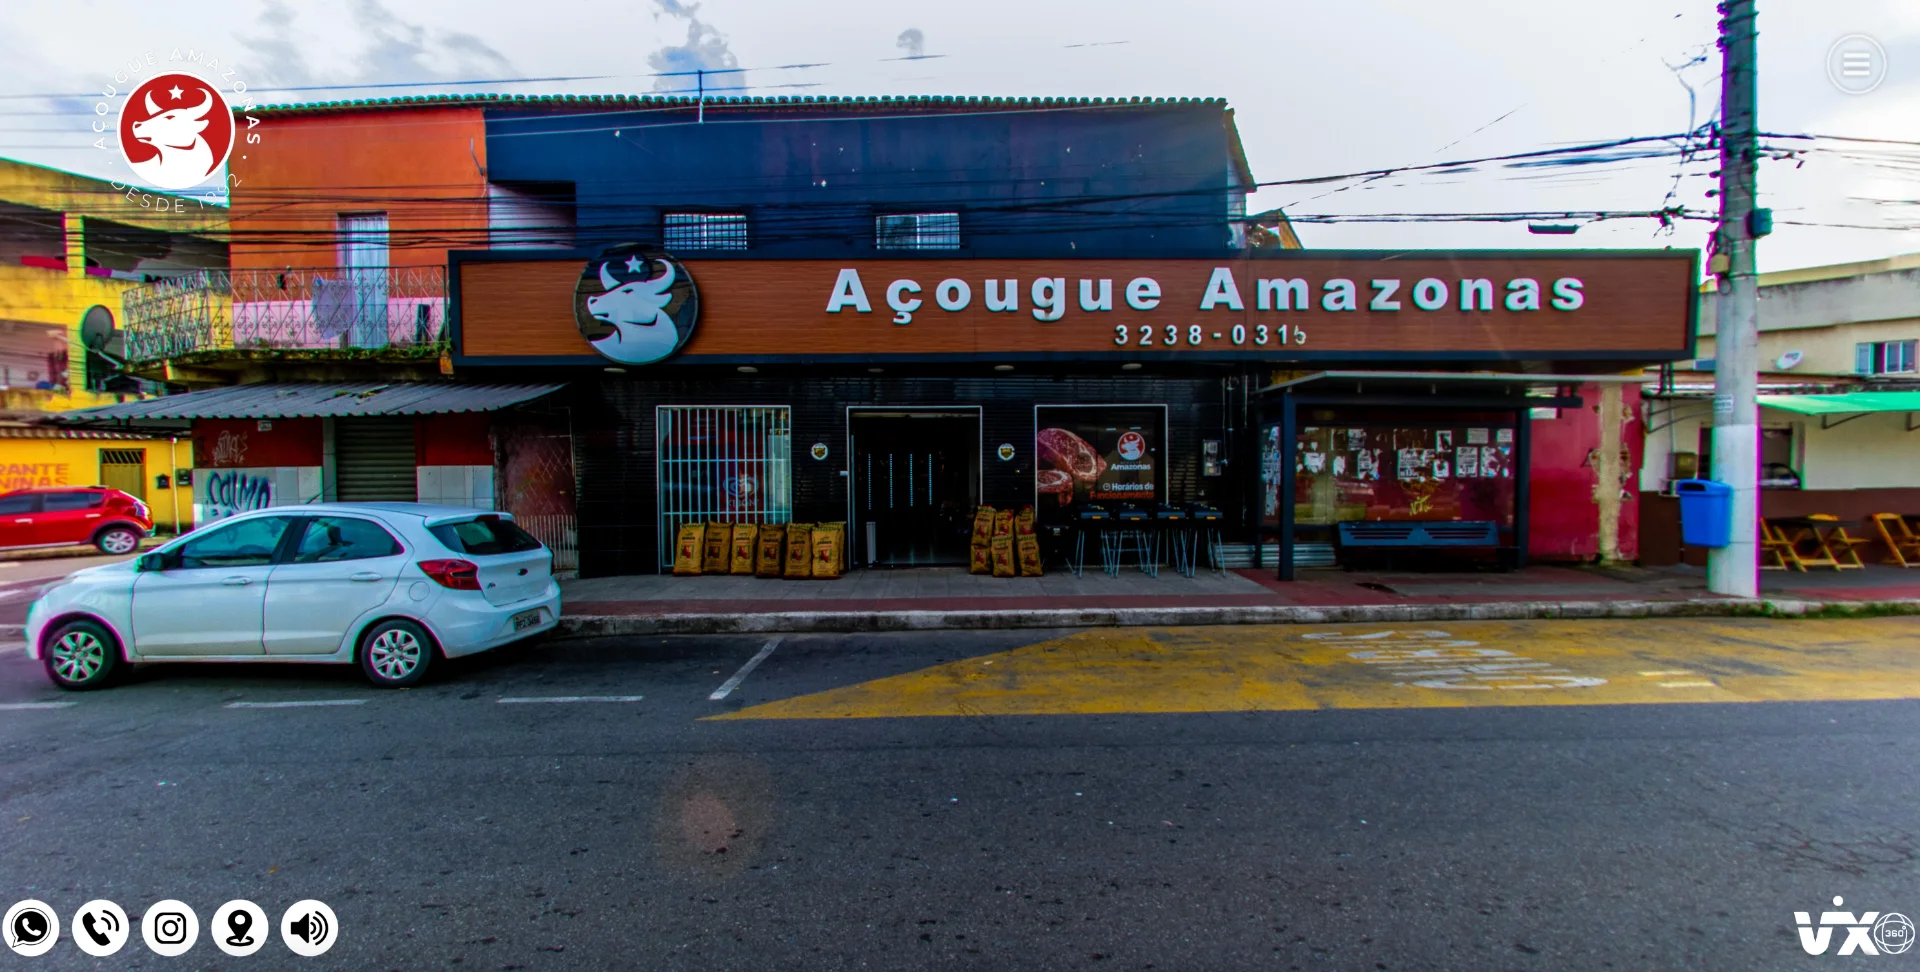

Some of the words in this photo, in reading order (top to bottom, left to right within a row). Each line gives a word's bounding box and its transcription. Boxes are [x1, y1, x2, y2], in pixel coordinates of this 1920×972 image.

[826, 268, 1162, 325] Açougue
[1200, 267, 1585, 312] Amazonas
[1110, 463, 1151, 471] Amazonas
[1111, 482, 1144, 491] Horários
[1144, 482, 1154, 491] de
